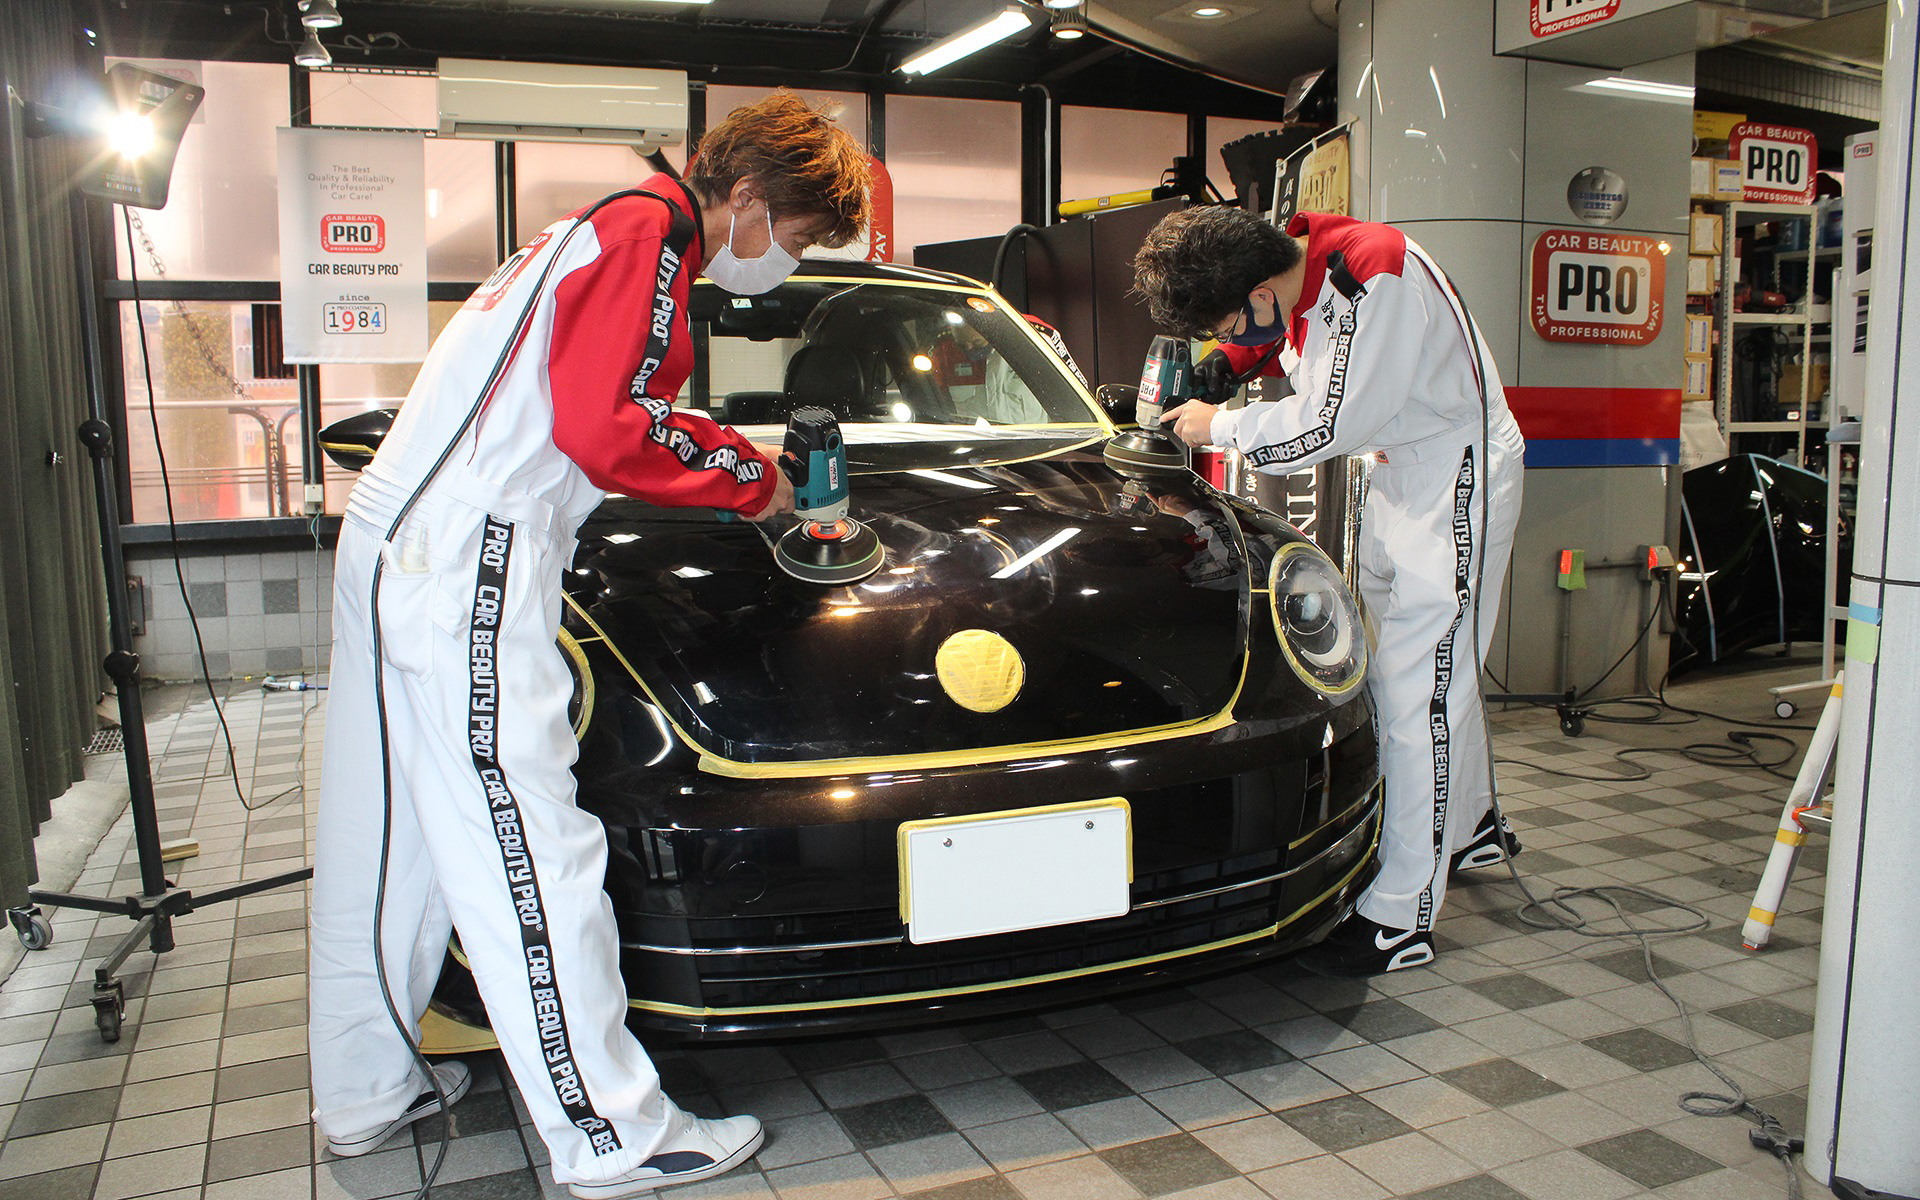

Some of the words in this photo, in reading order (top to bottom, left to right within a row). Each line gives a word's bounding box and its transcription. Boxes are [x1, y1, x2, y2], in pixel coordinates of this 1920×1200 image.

[1540, 8, 1608, 35] PROFESSIONAL
[1738, 125, 1762, 136] CAR
[1767, 127, 1810, 143] BEAUTY
[308, 173, 339, 182] Quality
[352, 175, 395, 184] Reliability
[332, 164, 348, 173] The
[352, 165, 370, 173] Best
[331, 183, 384, 192] Professional
[331, 192, 346, 200] Car
[1546, 234, 1581, 249] CAR
[1587, 236, 1653, 255] BEAUTY
[308, 263, 330, 275] CAR
[332, 264, 375, 276] BEAUTY
[328, 311, 382, 332] 1984
[1536, 294, 1548, 327] THE
[1646, 300, 1660, 332] WAY
[1550, 326, 1644, 340] PROFESSIONAL
[1329, 334, 1350, 396] BEAUTY
[630, 357, 661, 396] CAR
[704, 448, 738, 473] CAR
[1255, 439, 1306, 465] BEAUTY
[1301, 427, 1331, 453] CAR
[1453, 488, 1471, 546] BEAUTY
[474, 584, 501, 627] CAR
[470, 629, 496, 712] BEAUTY
[1430, 713, 1448, 742] CAR
[1434, 744, 1448, 801] BEAUTY
[480, 768, 511, 807] CAR
[494, 807, 532, 884] BEAUTY
[525, 943, 551, 986] CAR
[534, 986, 570, 1063] BEAUTY
